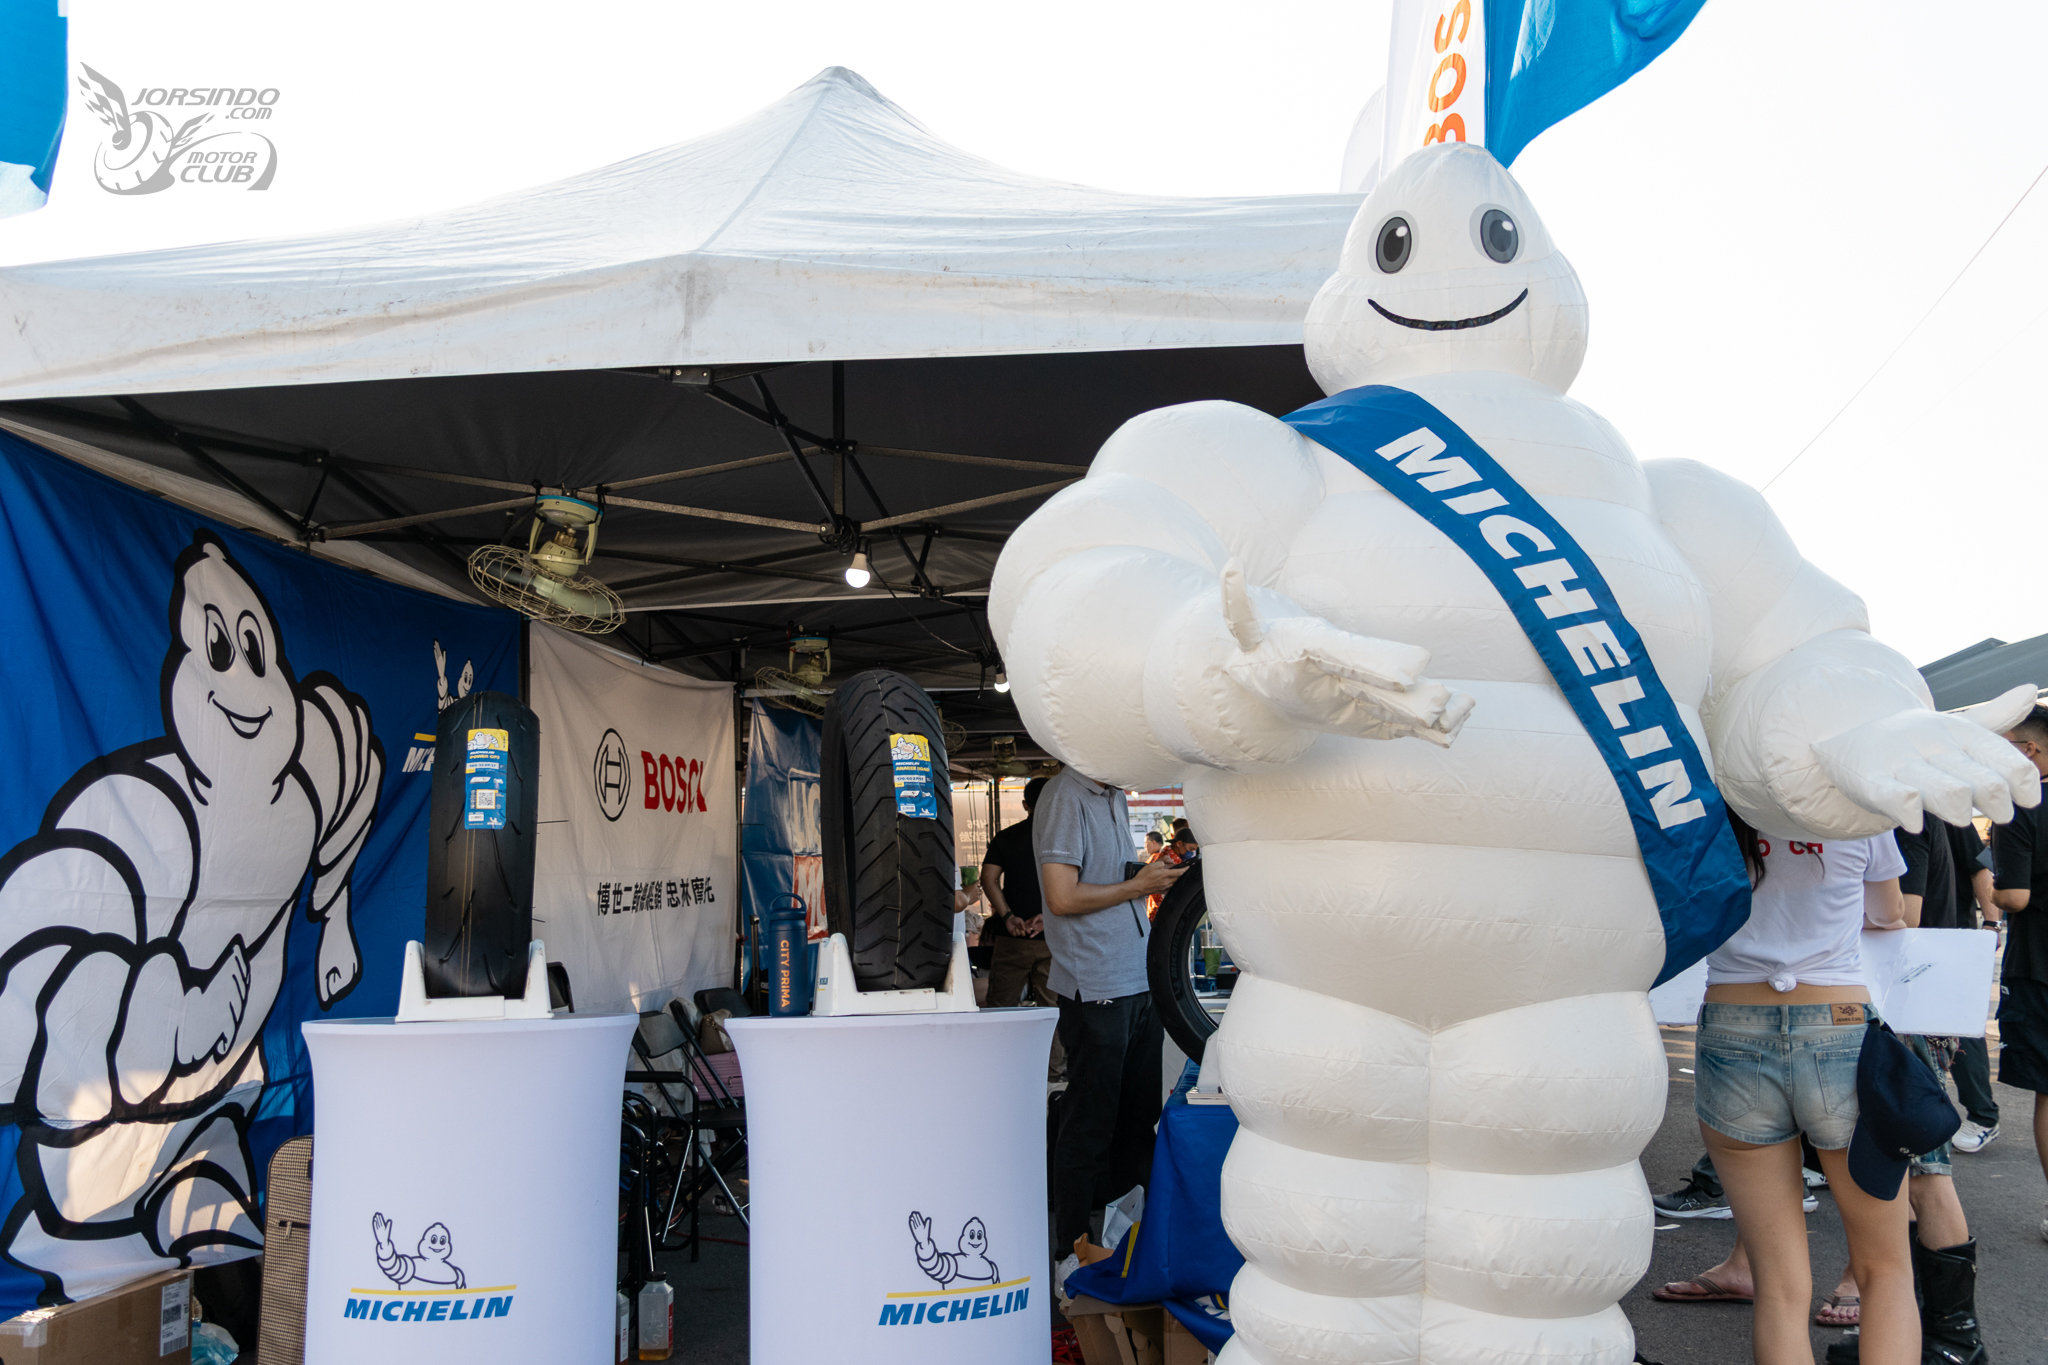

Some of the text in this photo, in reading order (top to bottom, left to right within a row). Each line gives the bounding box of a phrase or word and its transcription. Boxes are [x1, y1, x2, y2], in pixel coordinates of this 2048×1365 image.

[1374, 426, 1707, 830] MICHELIN
[780, 939, 791, 1008] CITY PRIMA
[343, 1295, 514, 1322] MICHELIN
[879, 1287, 1030, 1326] MICHELIN
